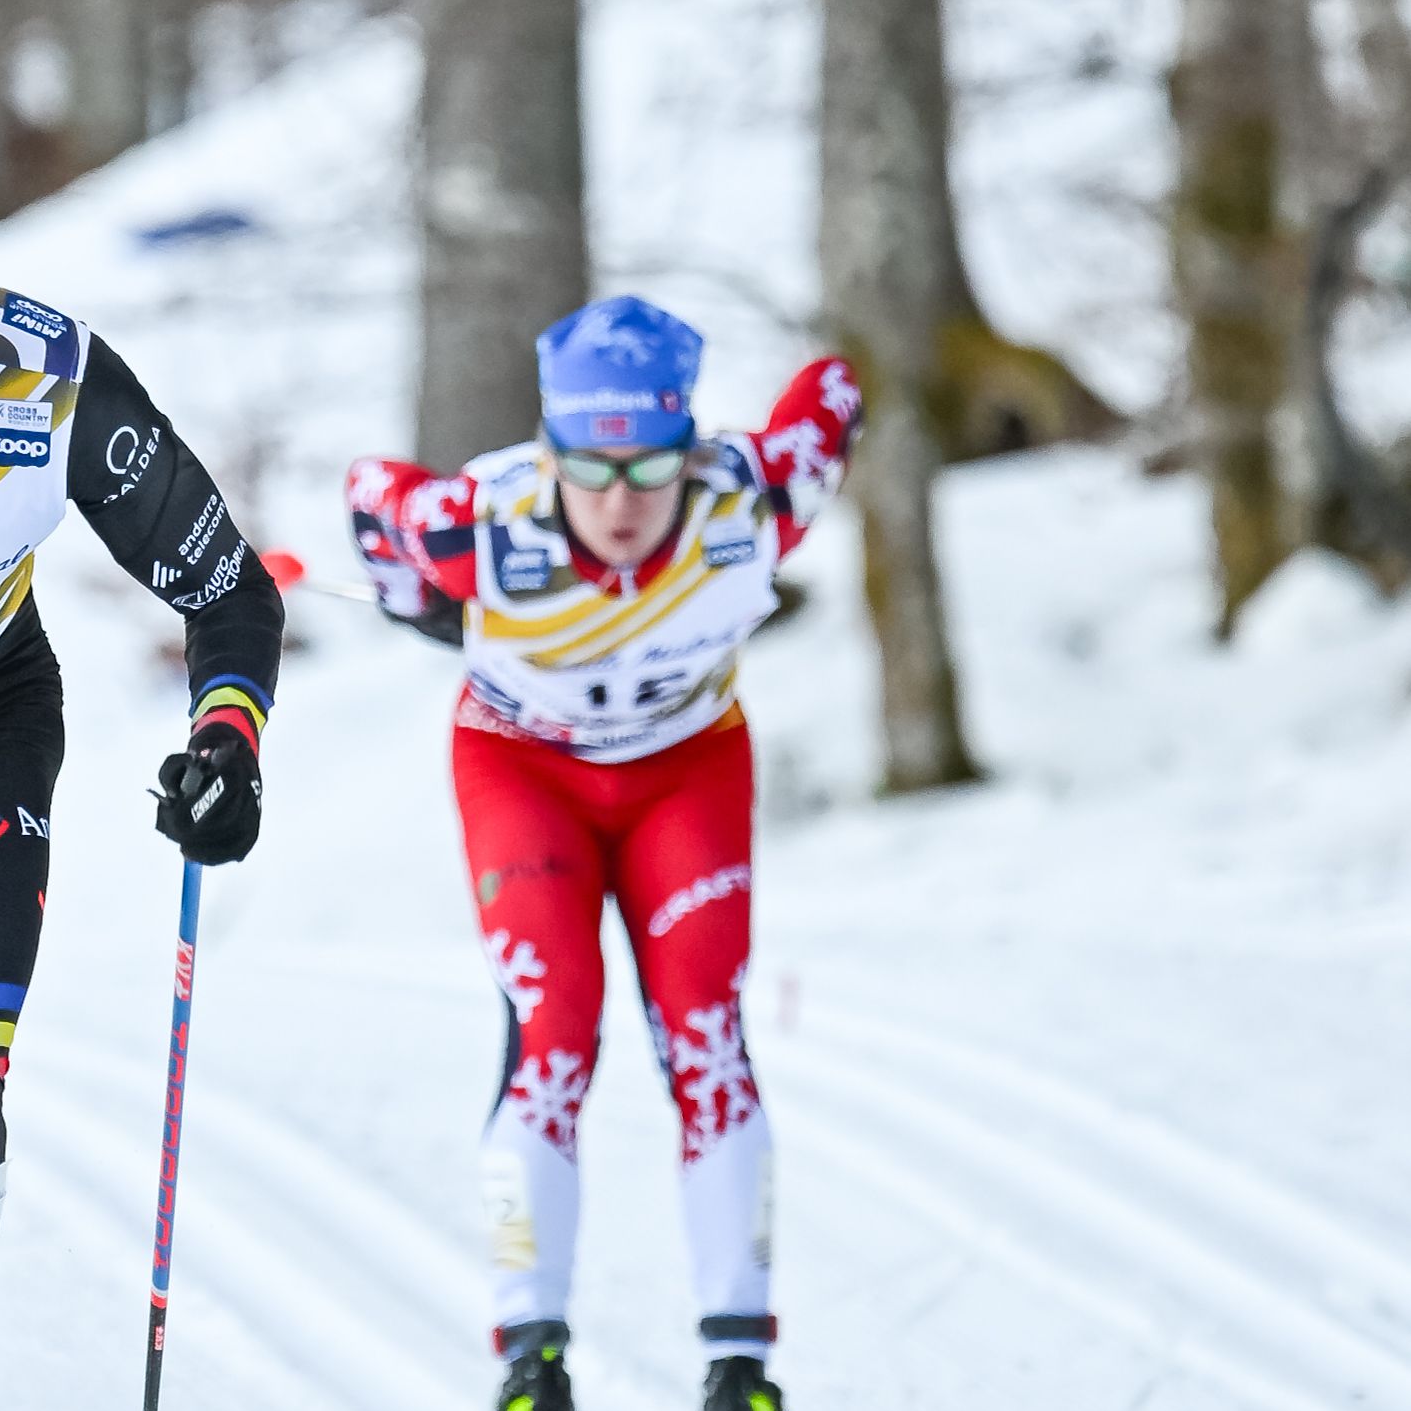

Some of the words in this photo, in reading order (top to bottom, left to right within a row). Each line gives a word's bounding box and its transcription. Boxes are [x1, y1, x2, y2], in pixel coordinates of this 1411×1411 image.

[7, 413, 49, 422] COUNTRY
[178, 494, 218, 556] andorra
[187, 501, 225, 565] telecom
